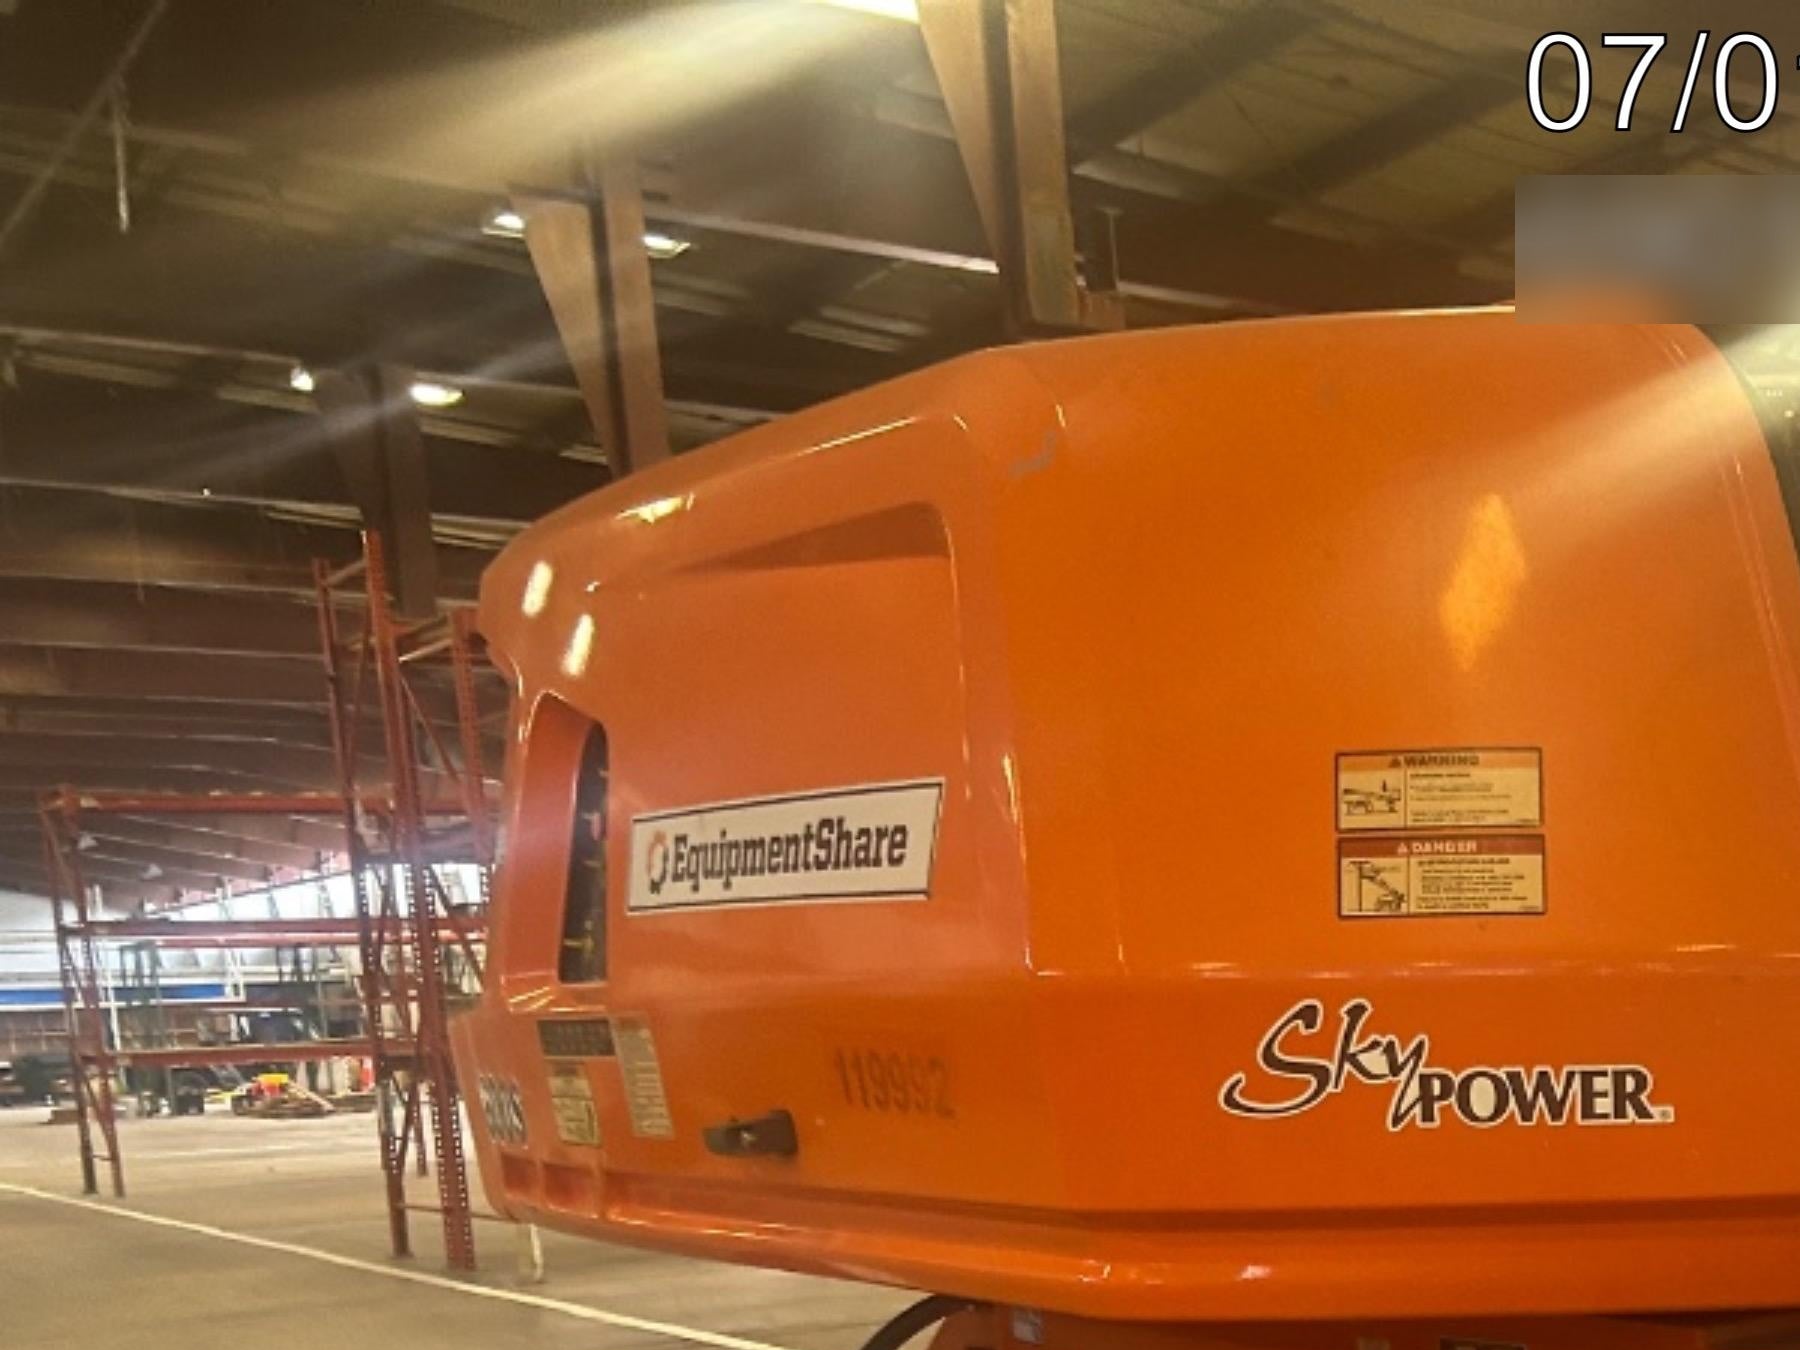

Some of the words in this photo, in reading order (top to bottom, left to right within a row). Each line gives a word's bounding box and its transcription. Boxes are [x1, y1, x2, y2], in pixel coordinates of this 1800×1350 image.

[671, 818, 907, 893] EquipmentShare
[1412, 841, 1477, 854] DANGER
[834, 1047, 957, 1119] 119992
[1219, 999, 1430, 1132] Sky
[1414, 1067, 1656, 1126] POWER
